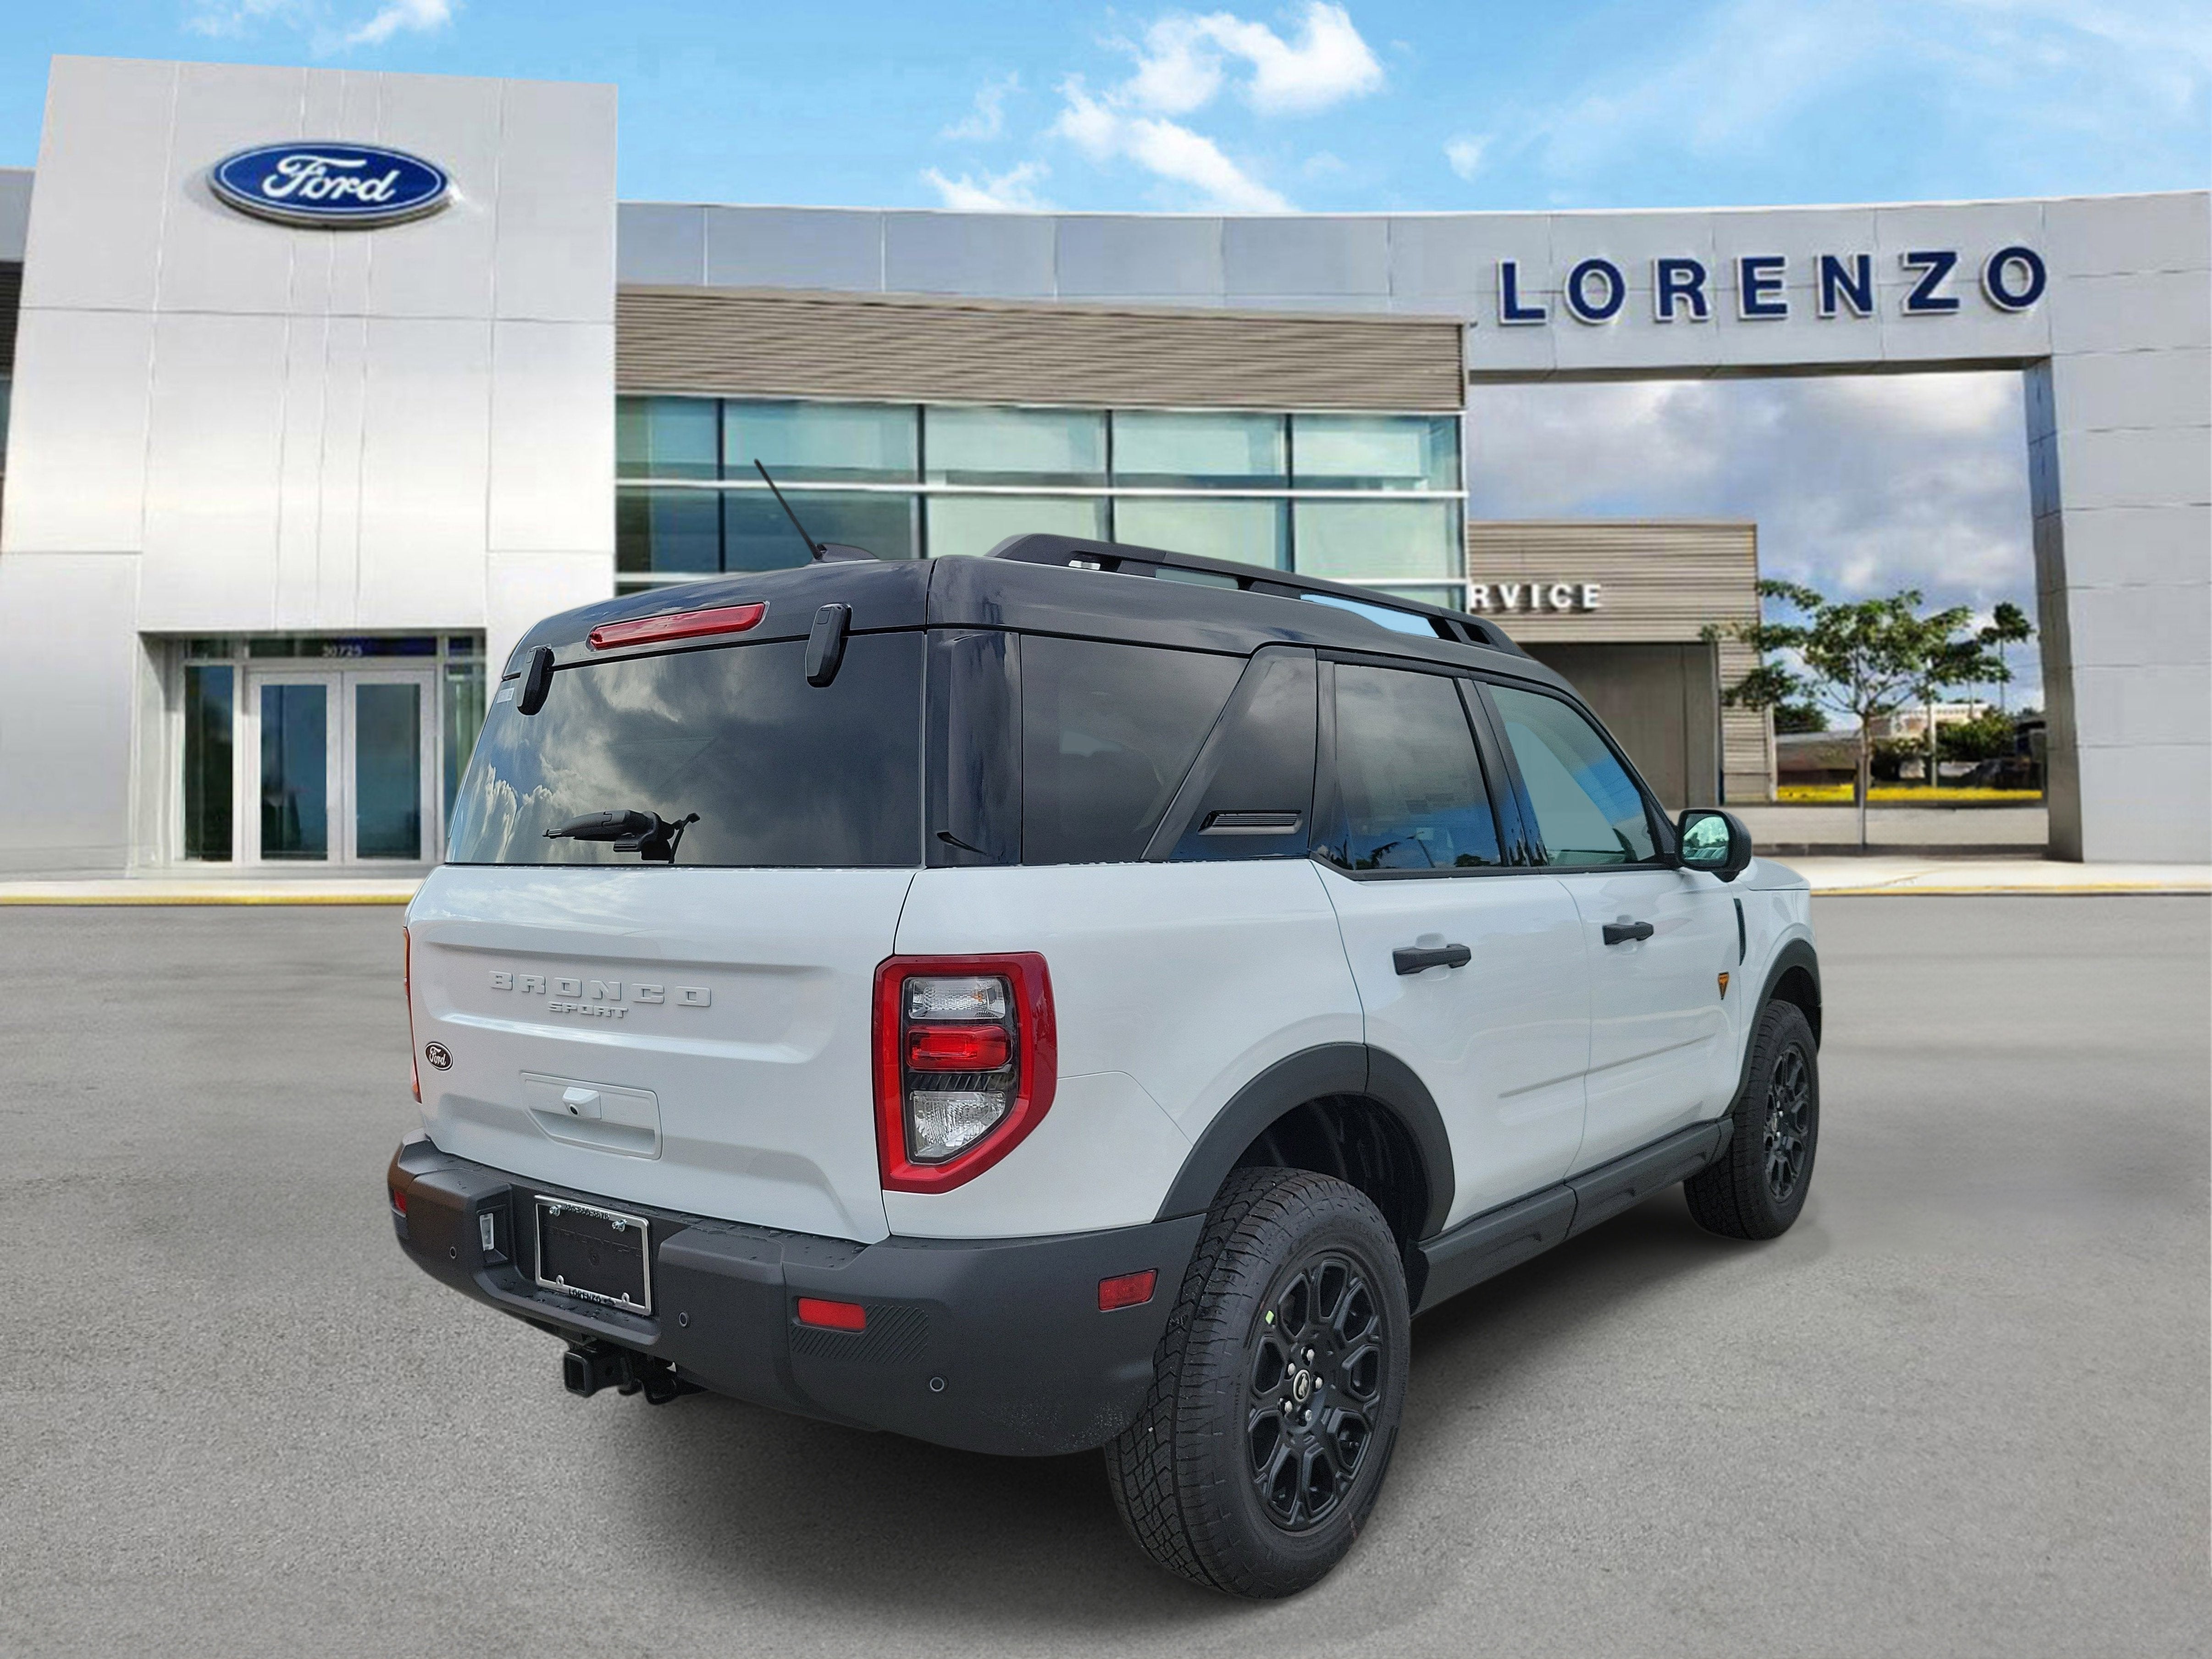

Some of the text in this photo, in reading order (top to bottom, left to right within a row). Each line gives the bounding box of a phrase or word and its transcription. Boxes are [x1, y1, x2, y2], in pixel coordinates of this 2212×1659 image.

[262, 154, 400, 202] Ford
[1498, 246, 2047, 326] LORENZO
[1470, 583, 1603, 608] RVICE
[488, 970, 712, 1007] BRONCO
[547, 1001, 629, 1018] SPORT
[429, 1046, 447, 1066] Ford
[569, 1288, 602, 1305] LORENZO
